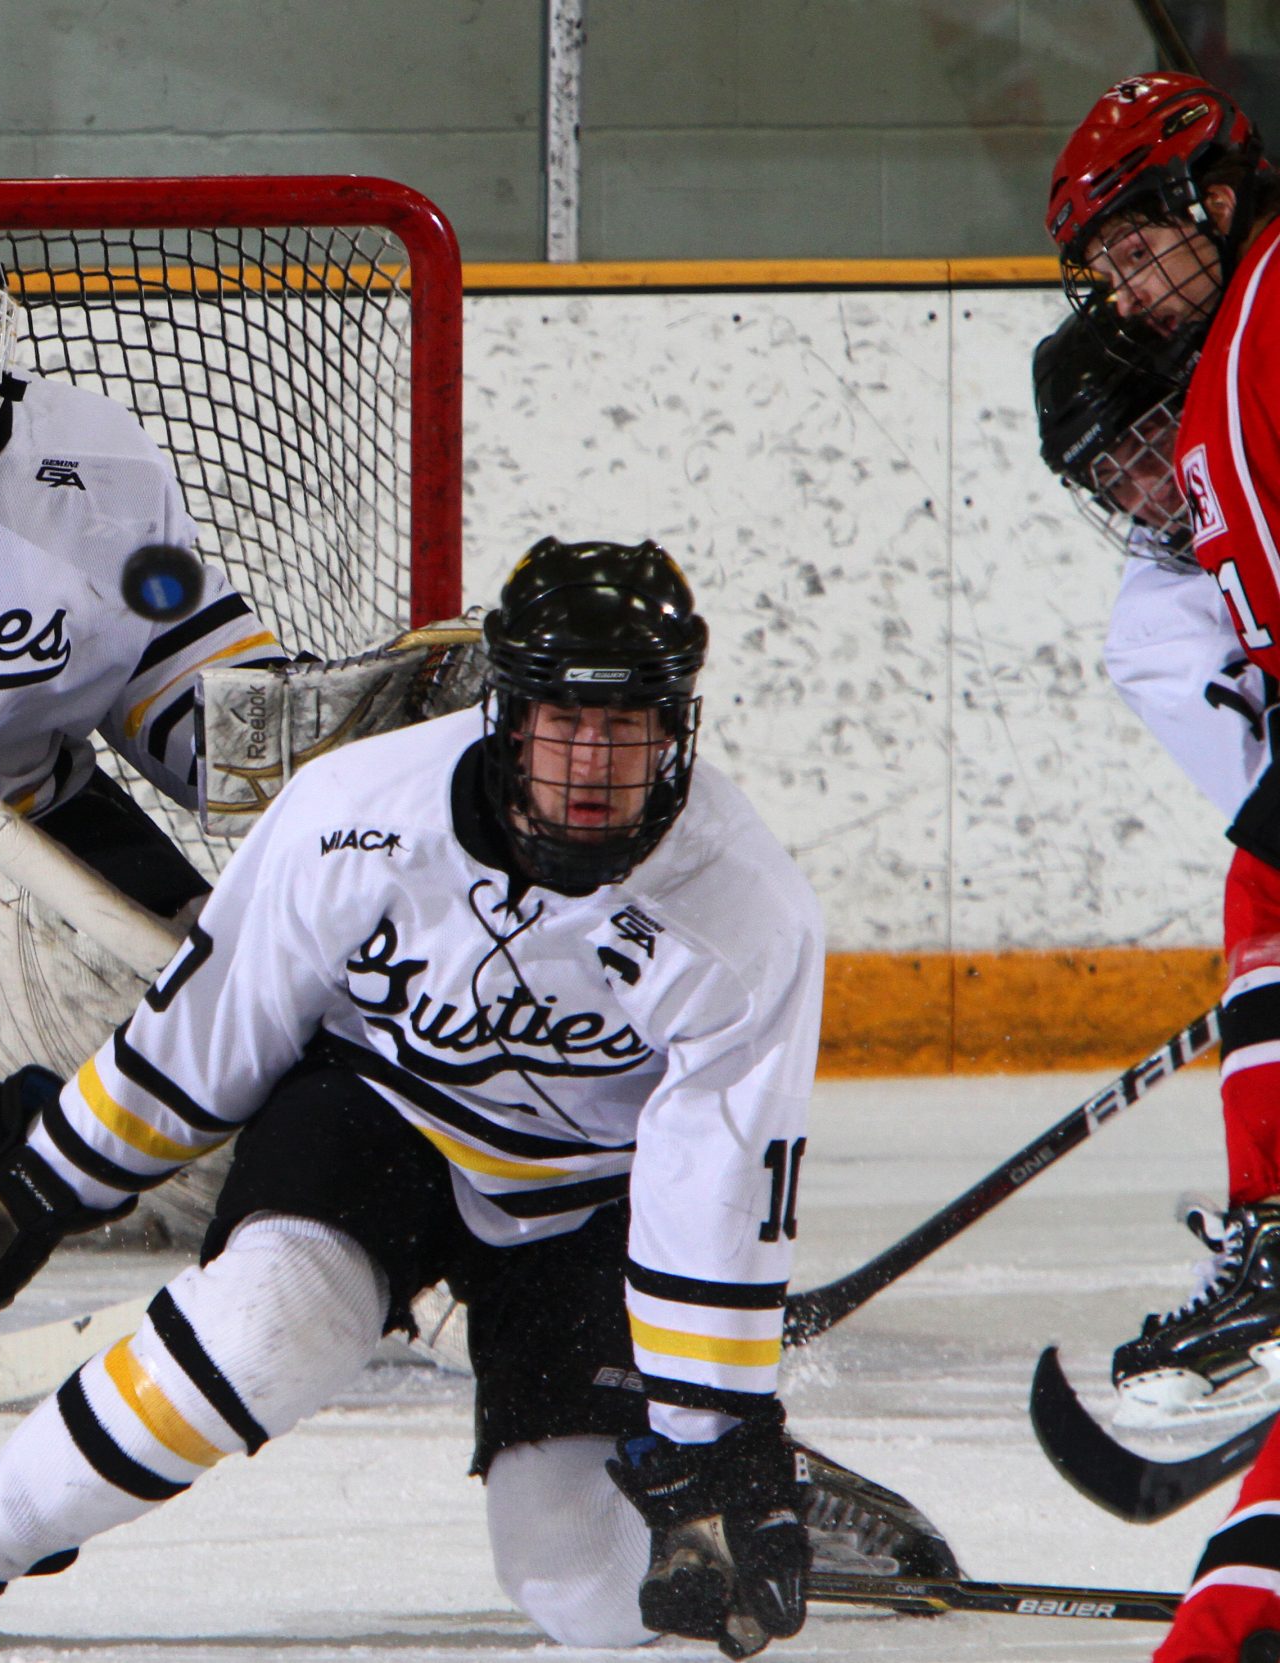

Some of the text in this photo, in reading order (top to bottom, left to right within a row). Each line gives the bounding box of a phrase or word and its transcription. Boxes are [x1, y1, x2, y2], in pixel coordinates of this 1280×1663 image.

[41, 459, 79, 468] GEMINI
[245, 685, 267, 760] Reebok
[346, 917, 649, 1059] Gusties
[1010, 1144, 1057, 1185] ONE
[896, 1585, 927, 1595] ONE
